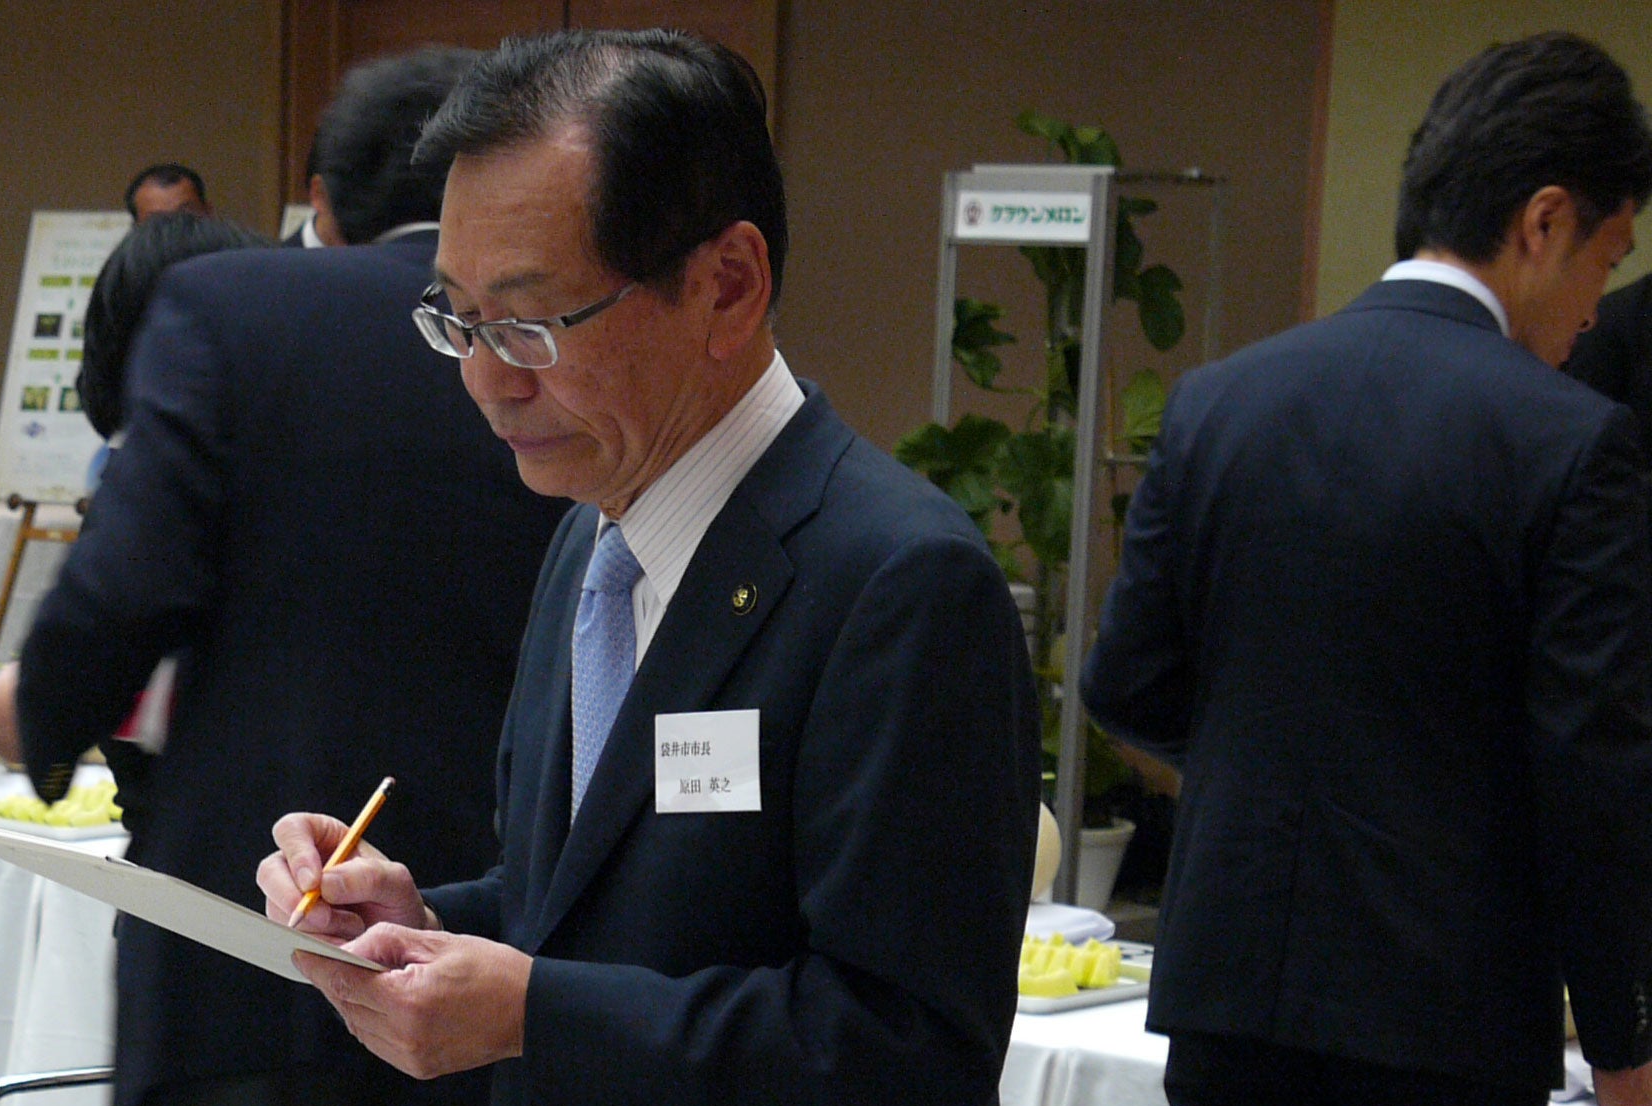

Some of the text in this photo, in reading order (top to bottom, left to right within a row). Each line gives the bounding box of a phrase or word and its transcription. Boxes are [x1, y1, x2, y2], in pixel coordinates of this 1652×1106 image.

[990, 204, 1085, 224] クラウンメロン
[661, 741, 711, 757] 袋井市市長
